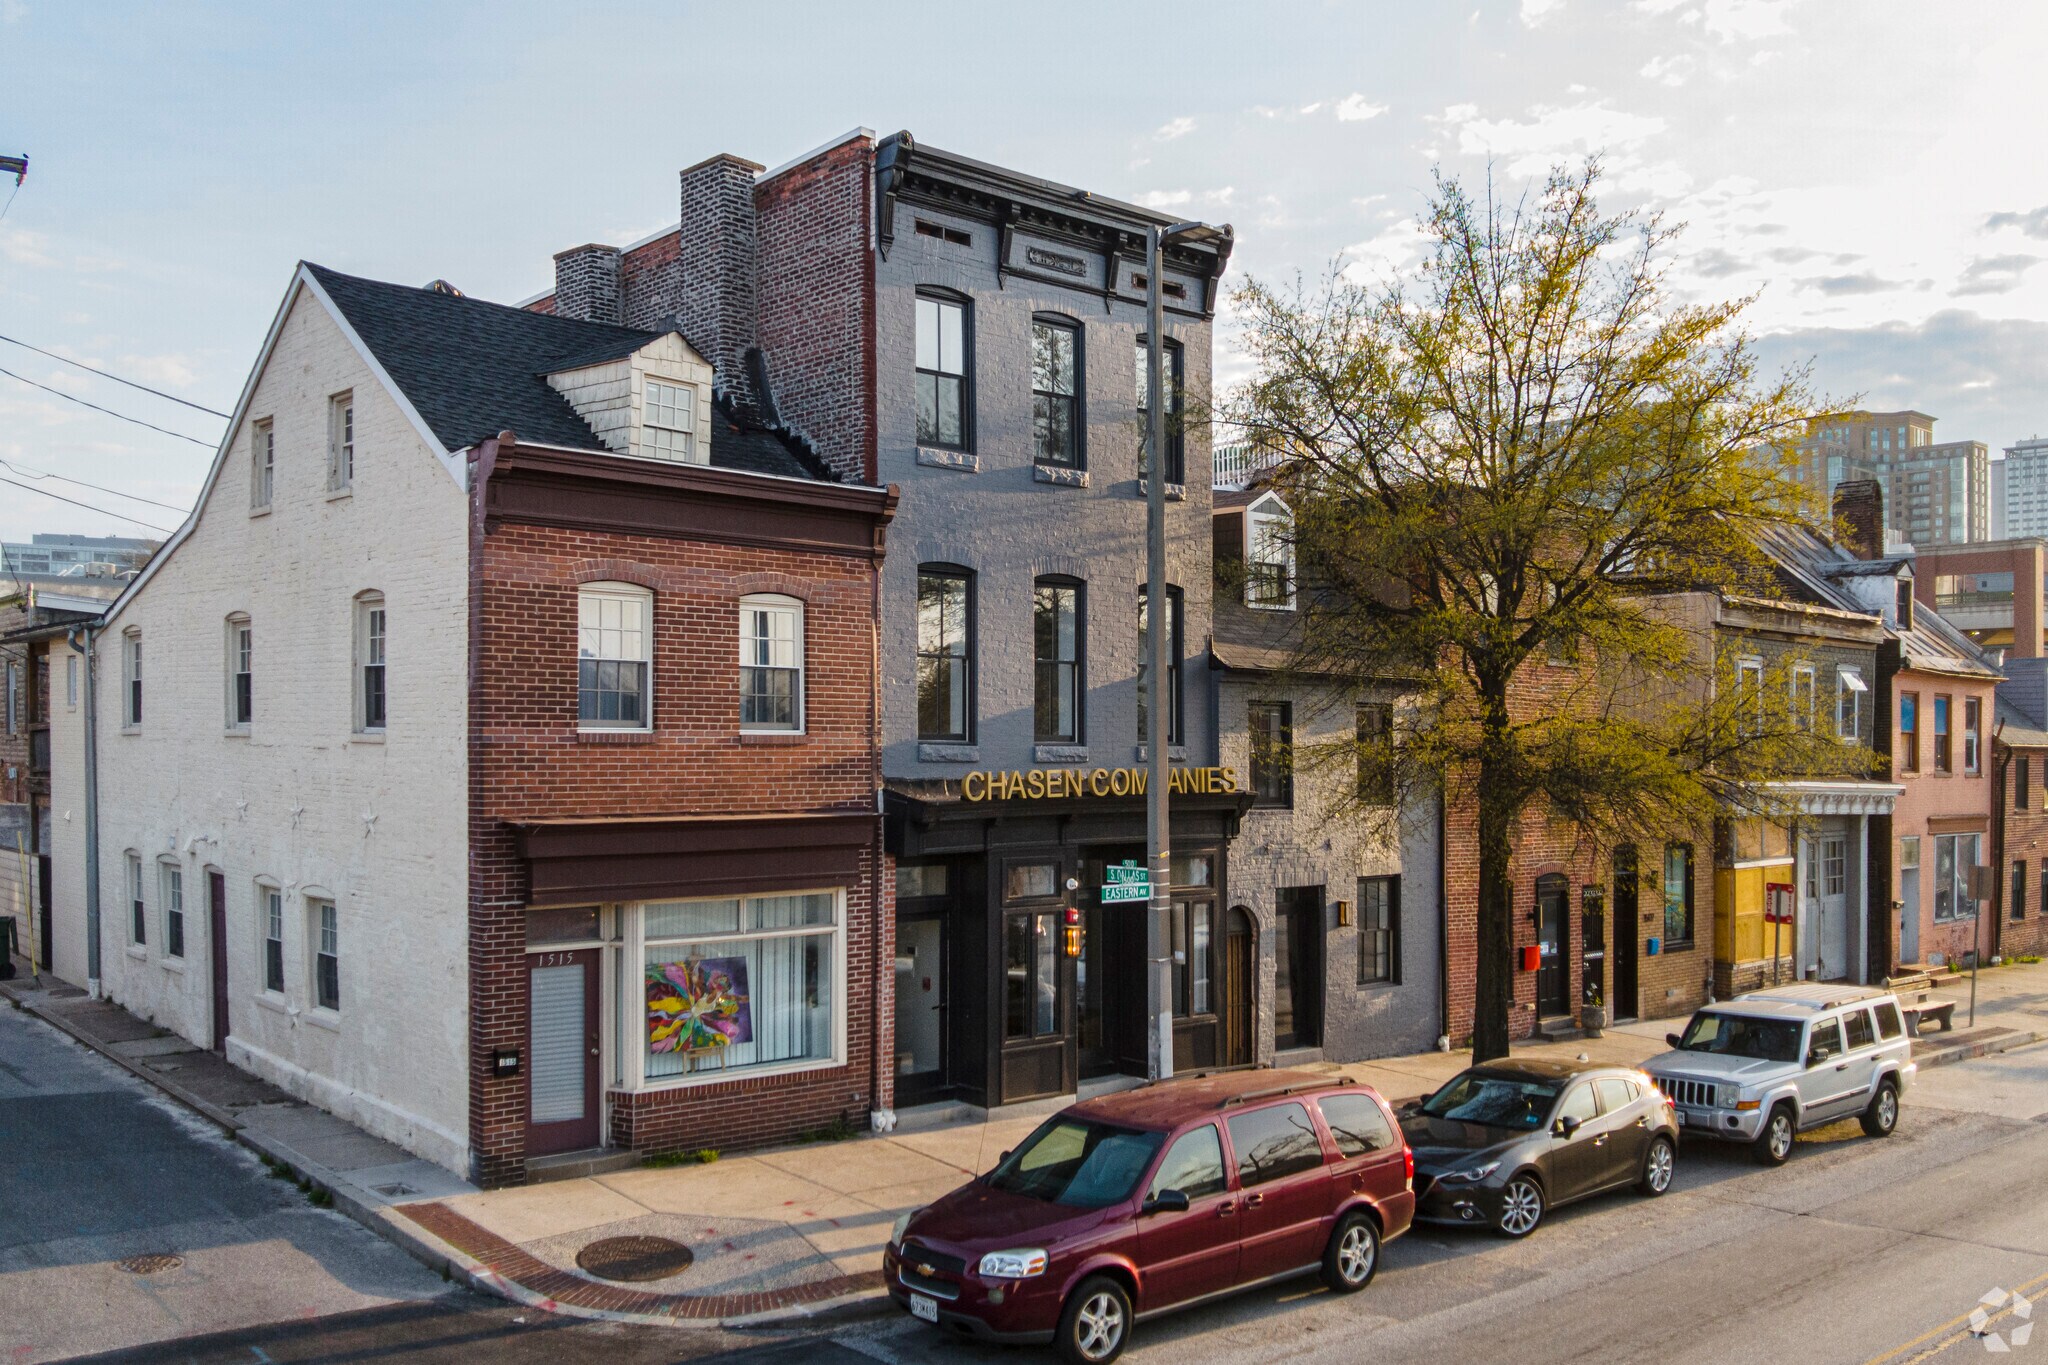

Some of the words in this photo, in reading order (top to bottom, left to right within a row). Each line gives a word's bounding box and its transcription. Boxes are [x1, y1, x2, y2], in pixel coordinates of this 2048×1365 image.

[962, 768, 1082, 801] CHASEN
[1089, 767, 1236, 796] COMANIES
[1106, 886, 1138, 899] EASTERN
[539, 952, 573, 967] 1515
